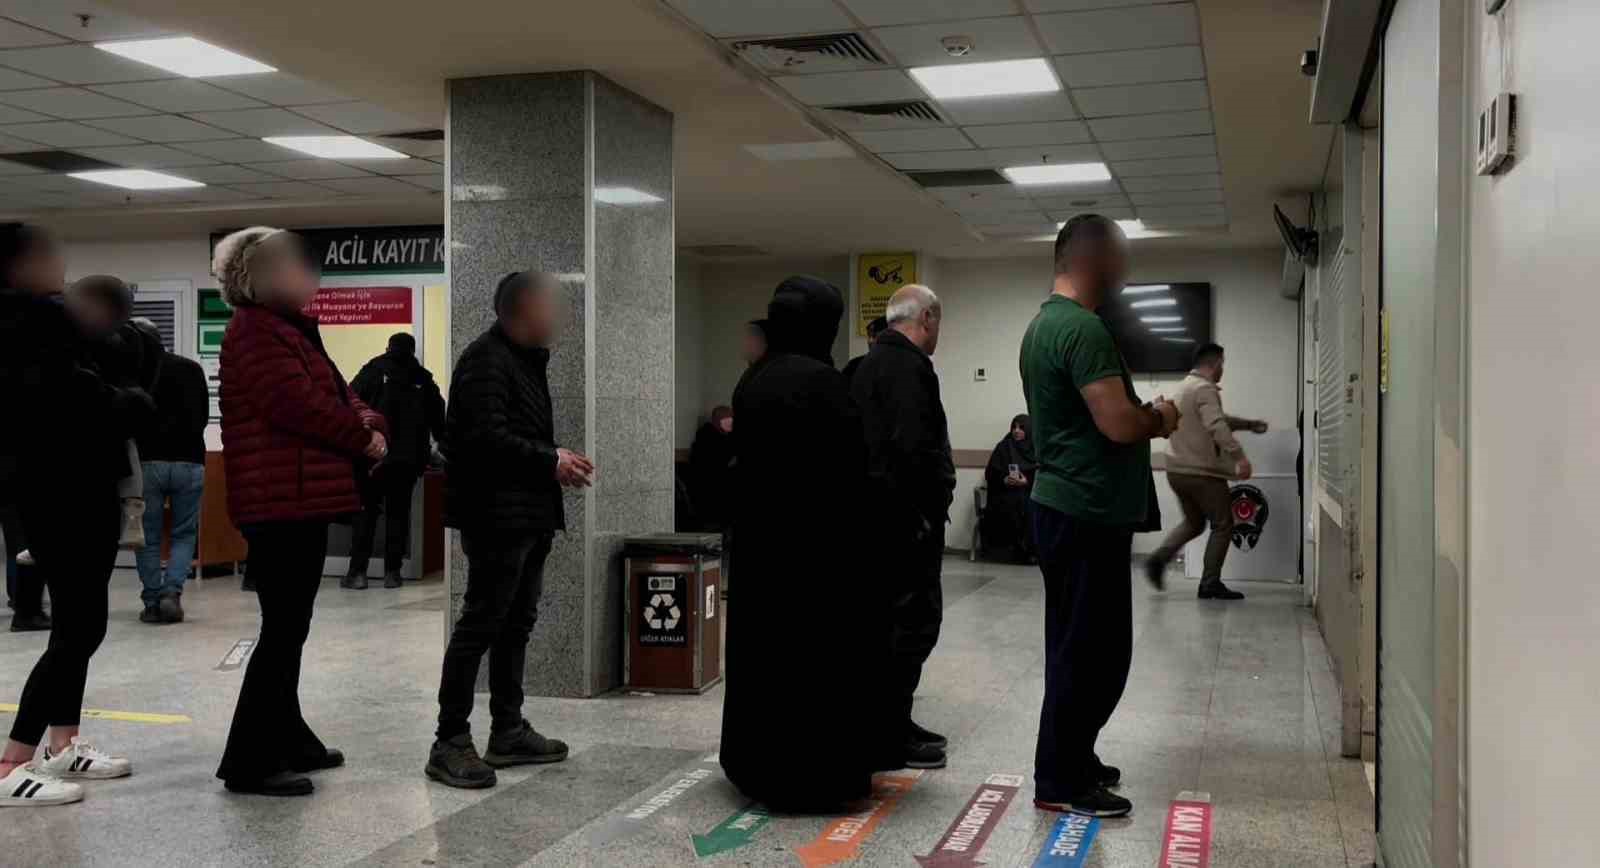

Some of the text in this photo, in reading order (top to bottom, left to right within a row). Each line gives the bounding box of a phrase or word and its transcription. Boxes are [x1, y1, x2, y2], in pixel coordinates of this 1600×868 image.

[324, 234, 367, 264] ACİL
[372, 238, 430, 264] KAYIT
[1172, 805, 1204, 833] KAN
